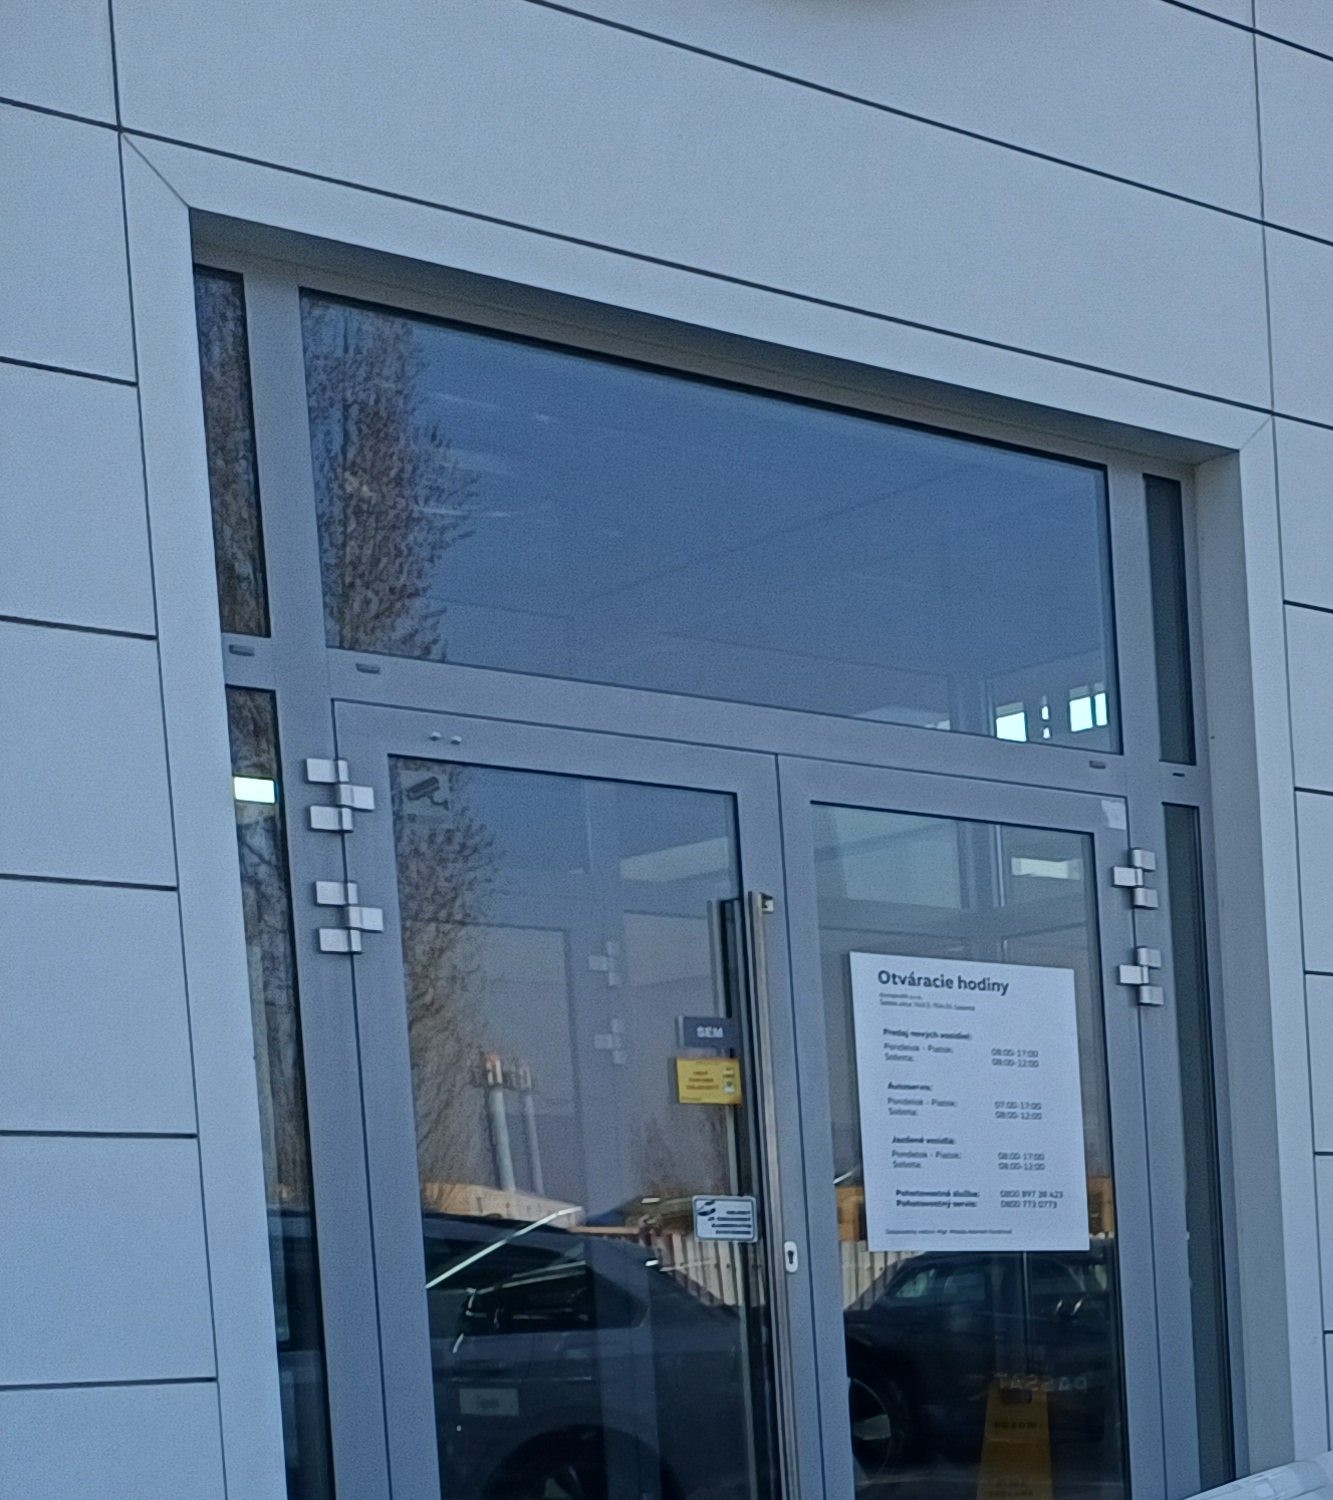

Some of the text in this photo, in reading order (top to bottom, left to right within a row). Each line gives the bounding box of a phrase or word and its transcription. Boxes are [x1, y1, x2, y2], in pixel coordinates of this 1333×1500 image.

[877, 969, 1009, 996] Otváracie hodiny
[696, 1026, 724, 1039] SEM
